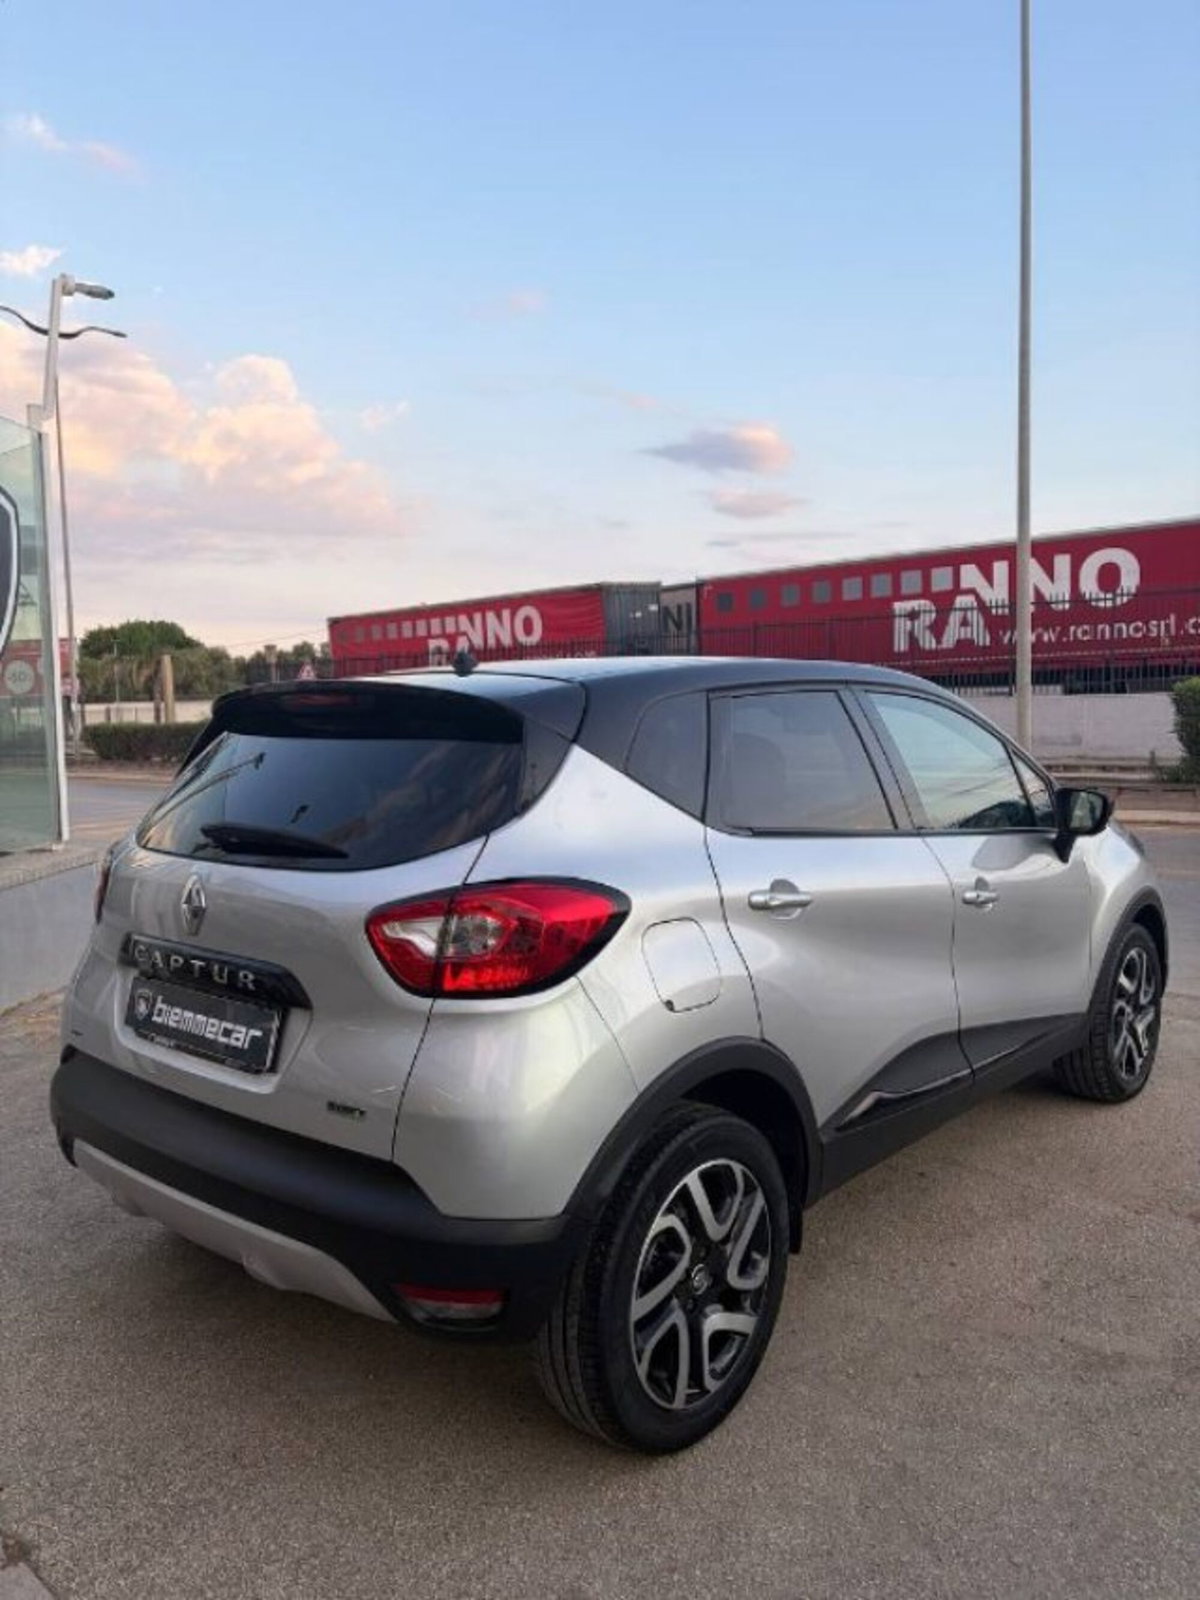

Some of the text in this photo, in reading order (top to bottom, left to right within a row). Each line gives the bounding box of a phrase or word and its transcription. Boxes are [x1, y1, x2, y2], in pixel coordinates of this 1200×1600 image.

[894, 547, 1141, 652] RANNO
[133, 945, 257, 991] CAPTUR
[152, 995, 262, 1049] biemmecar
